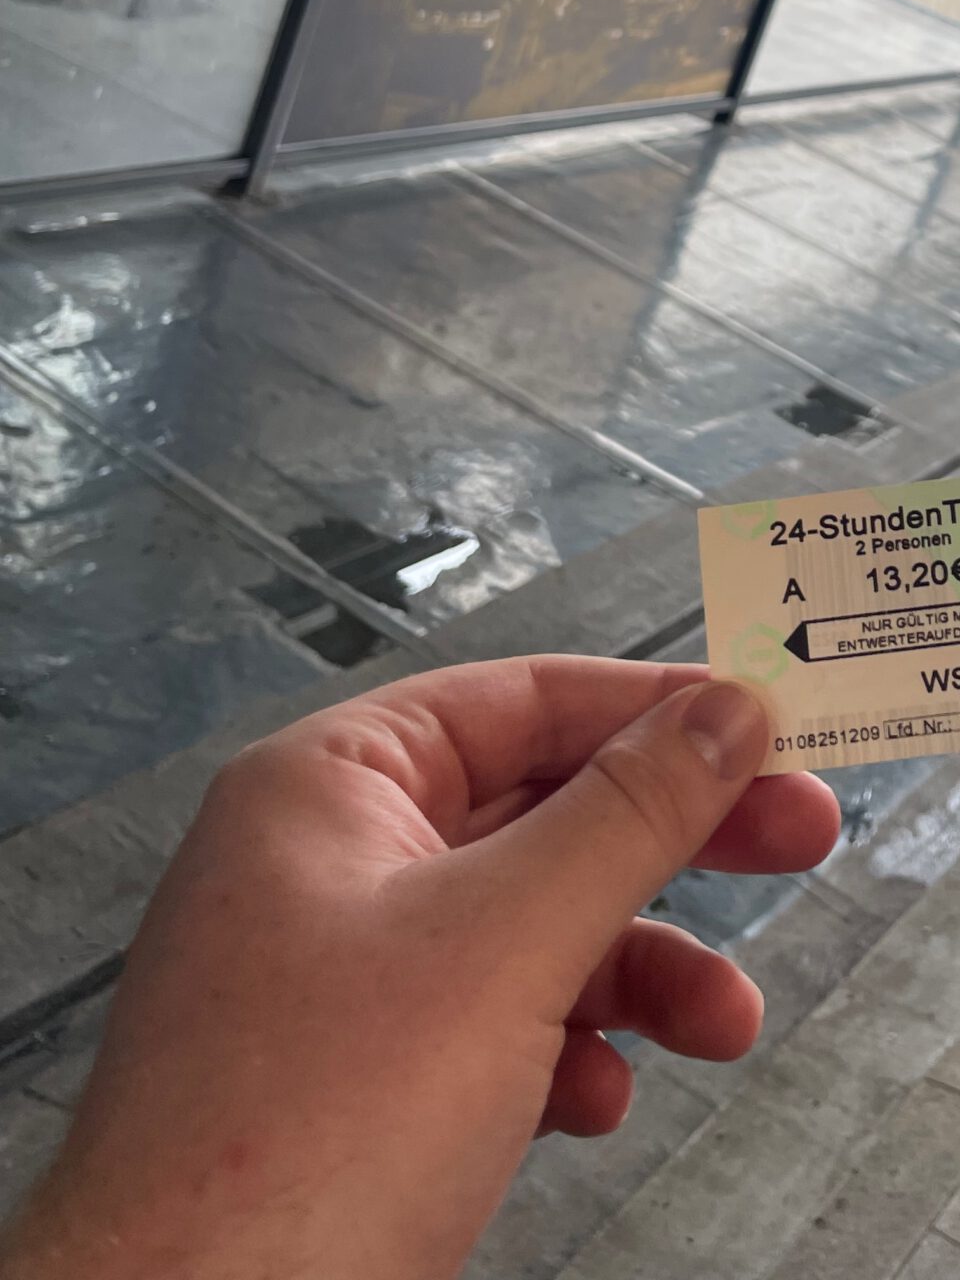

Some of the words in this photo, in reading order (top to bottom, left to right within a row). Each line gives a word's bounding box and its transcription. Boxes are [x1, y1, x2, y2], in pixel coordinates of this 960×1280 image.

[855, 540, 866, 556] 2
[872, 532, 952, 554] Personen
[782, 577, 807, 604] A
[861, 619, 893, 634] NUR
[896, 612, 949, 629] GÜLTIG
[774, 725, 881, 752] 0108251209
